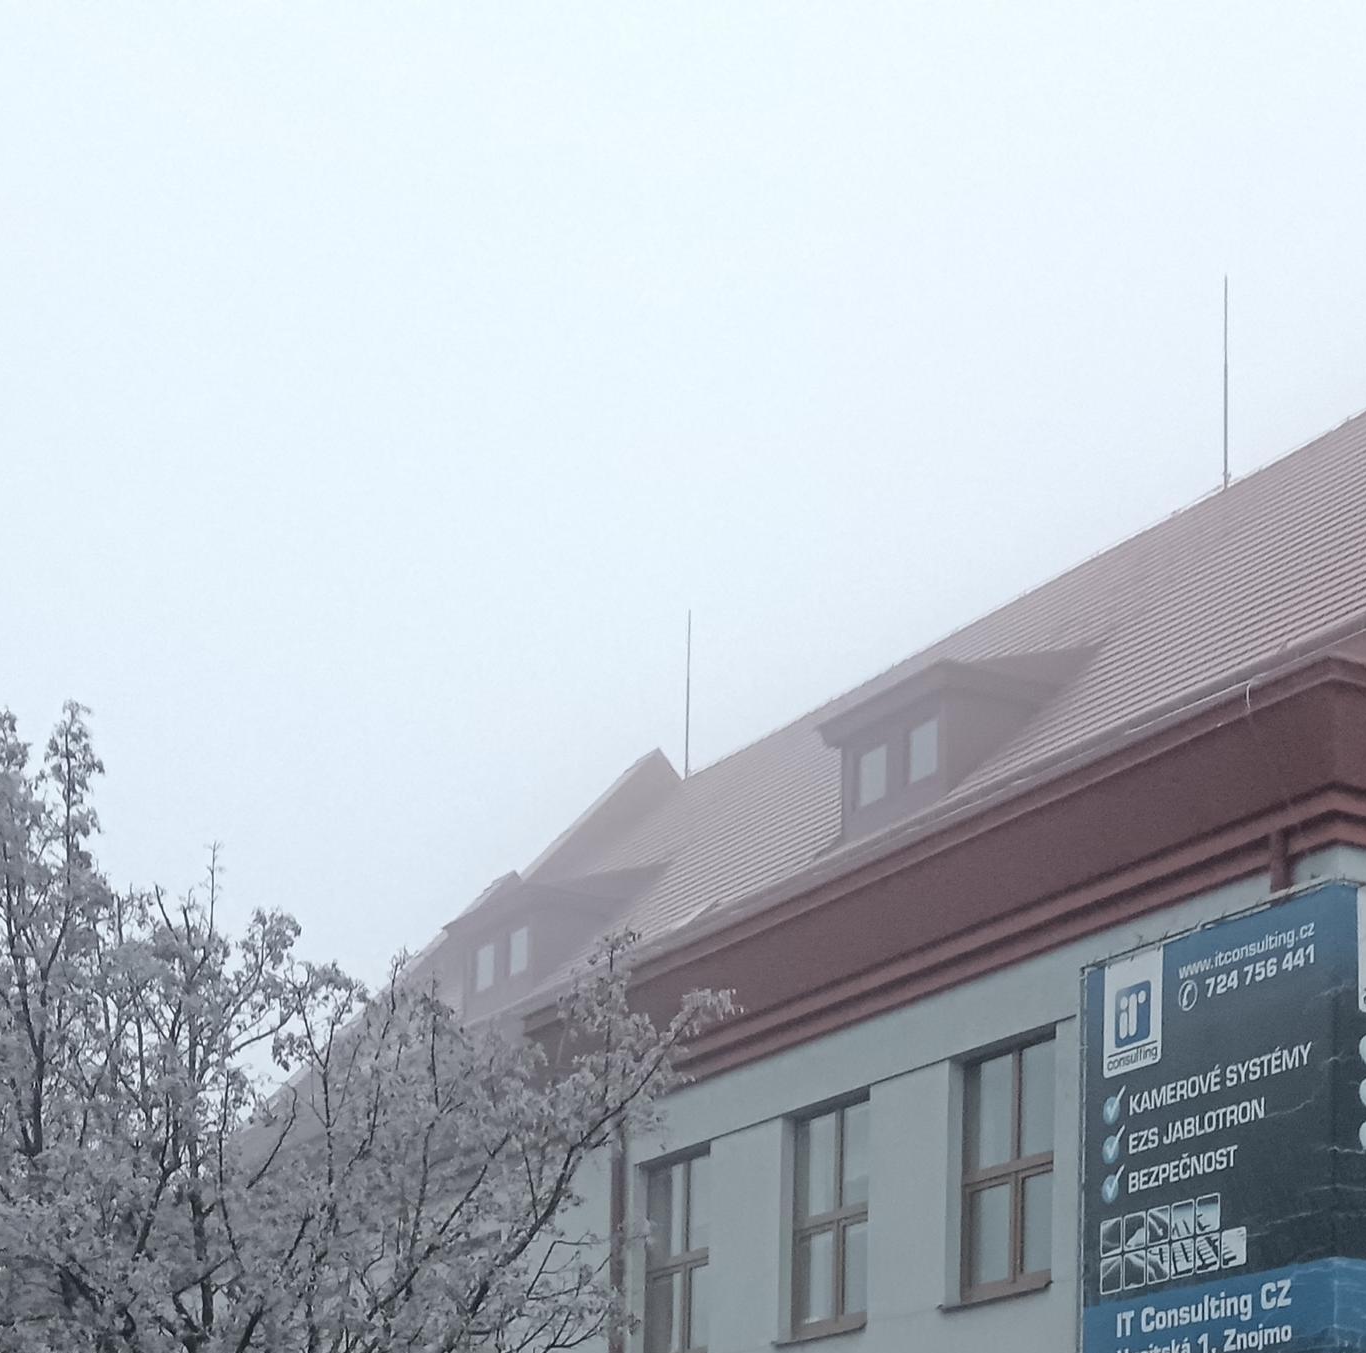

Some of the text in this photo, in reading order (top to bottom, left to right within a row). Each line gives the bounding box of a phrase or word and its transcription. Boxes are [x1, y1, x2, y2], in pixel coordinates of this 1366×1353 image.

[1178, 922, 1315, 979] www.itconsulting.cz
[1205, 944, 1315, 998] 724 756 441
[1107, 1046, 1158, 1071] consulting
[1129, 1041, 1313, 1116] KAMEROVÉ SYSTÉMY
[1128, 1096, 1266, 1154] EZS JABLOTRON
[1128, 1145, 1238, 1194] BEZPEČNOST
[1116, 1279, 1292, 1338] IT Consulting CZ
[1223, 1323, 1292, 1352] Znojmo
